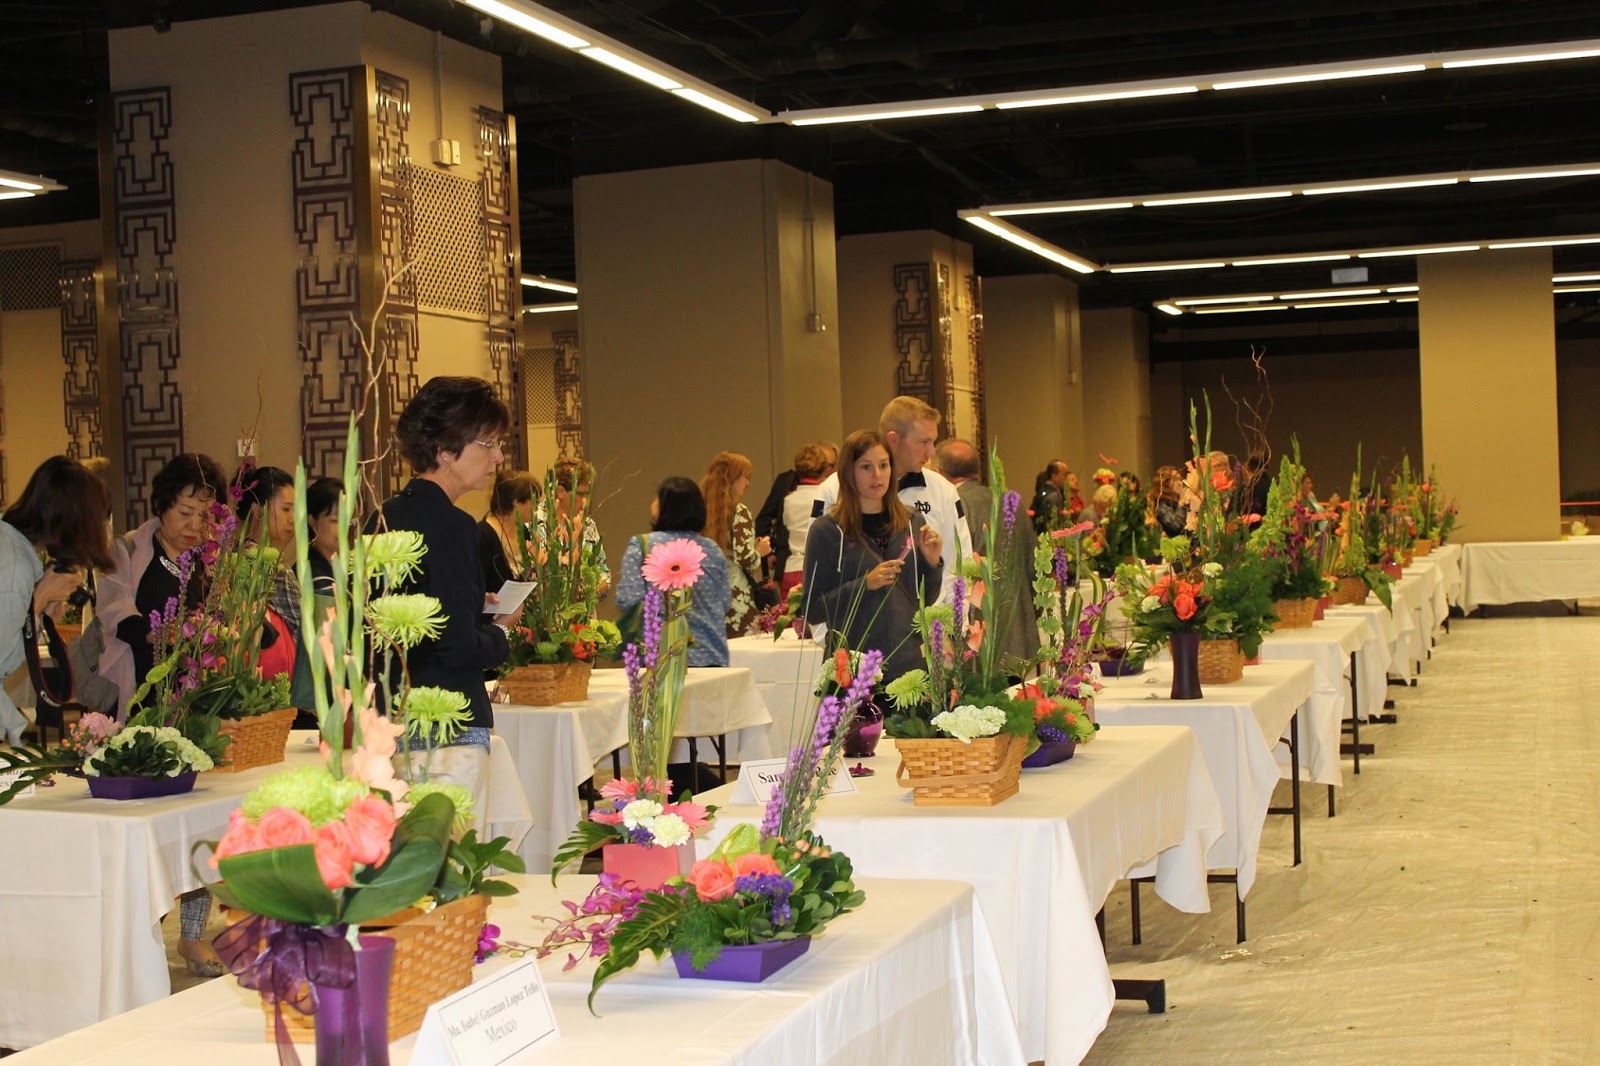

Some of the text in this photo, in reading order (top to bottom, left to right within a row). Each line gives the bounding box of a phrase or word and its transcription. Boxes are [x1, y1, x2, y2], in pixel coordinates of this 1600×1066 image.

[461, 1012, 481, 1031] Isabel
[480, 1002, 506, 1020] Guzman
[505, 991, 524, 1006] Lopez
[523, 982, 539, 997] Tello
[485, 1018, 517, 1043] Mexico
